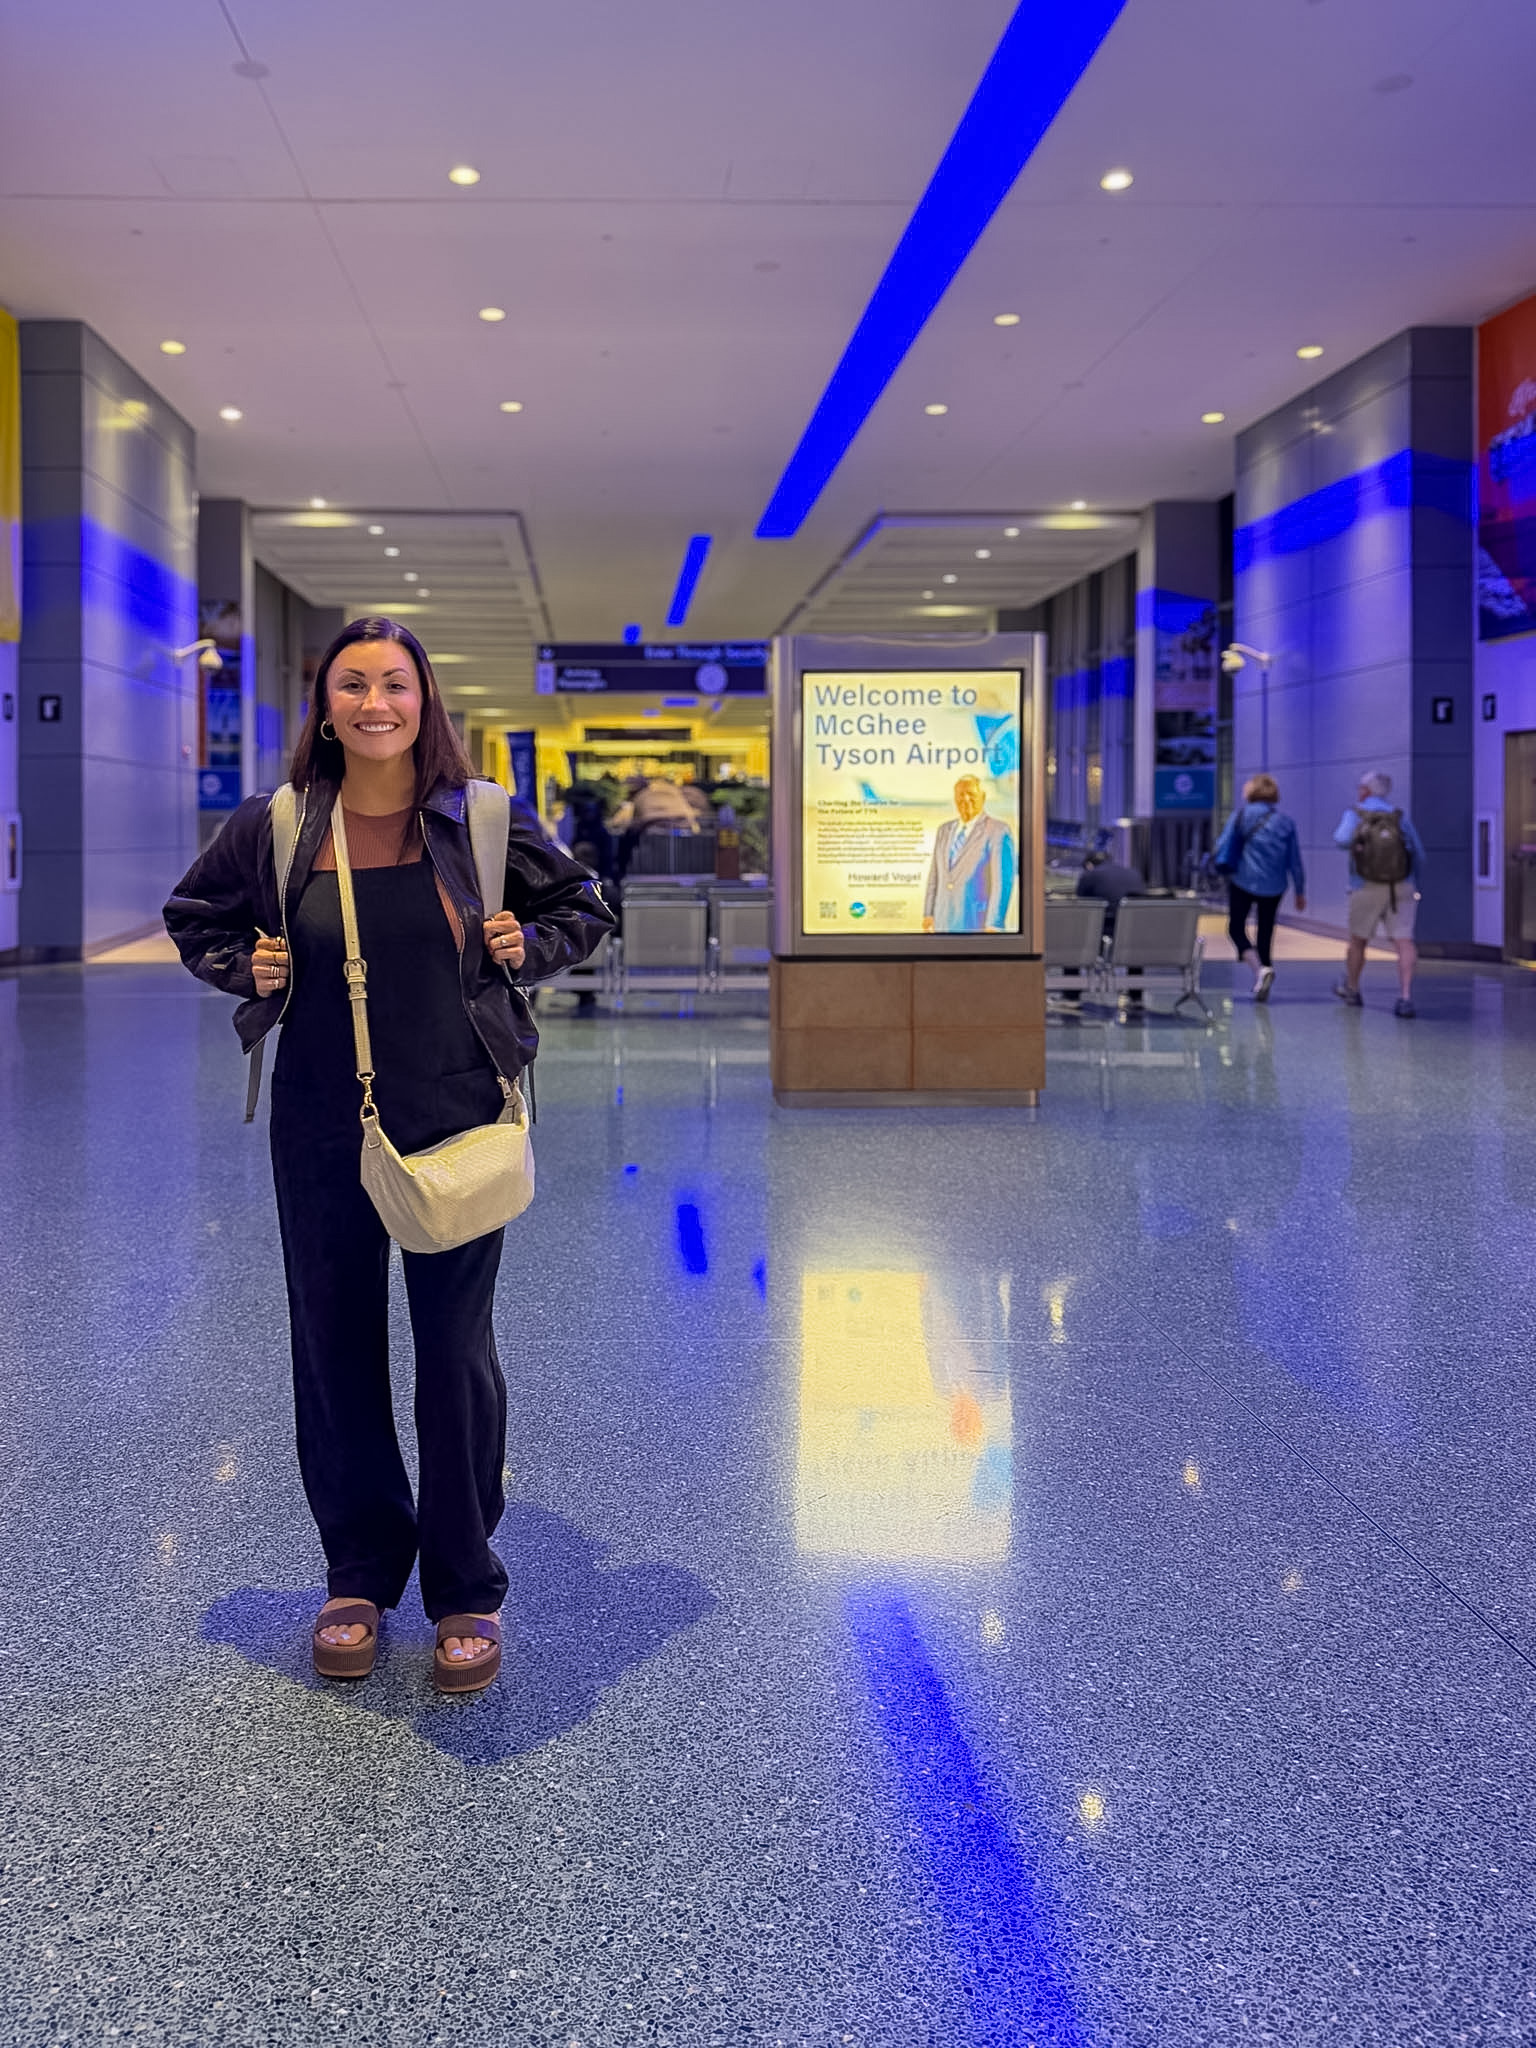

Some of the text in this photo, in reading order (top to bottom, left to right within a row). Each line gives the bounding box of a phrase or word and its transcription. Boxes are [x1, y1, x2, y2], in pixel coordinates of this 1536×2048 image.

[815, 684, 978, 706] Welcome to
[815, 713, 927, 735] McGhee
[816, 742, 1001, 770] Tyson Airport
[848, 872, 921, 882] Howard Vogel
